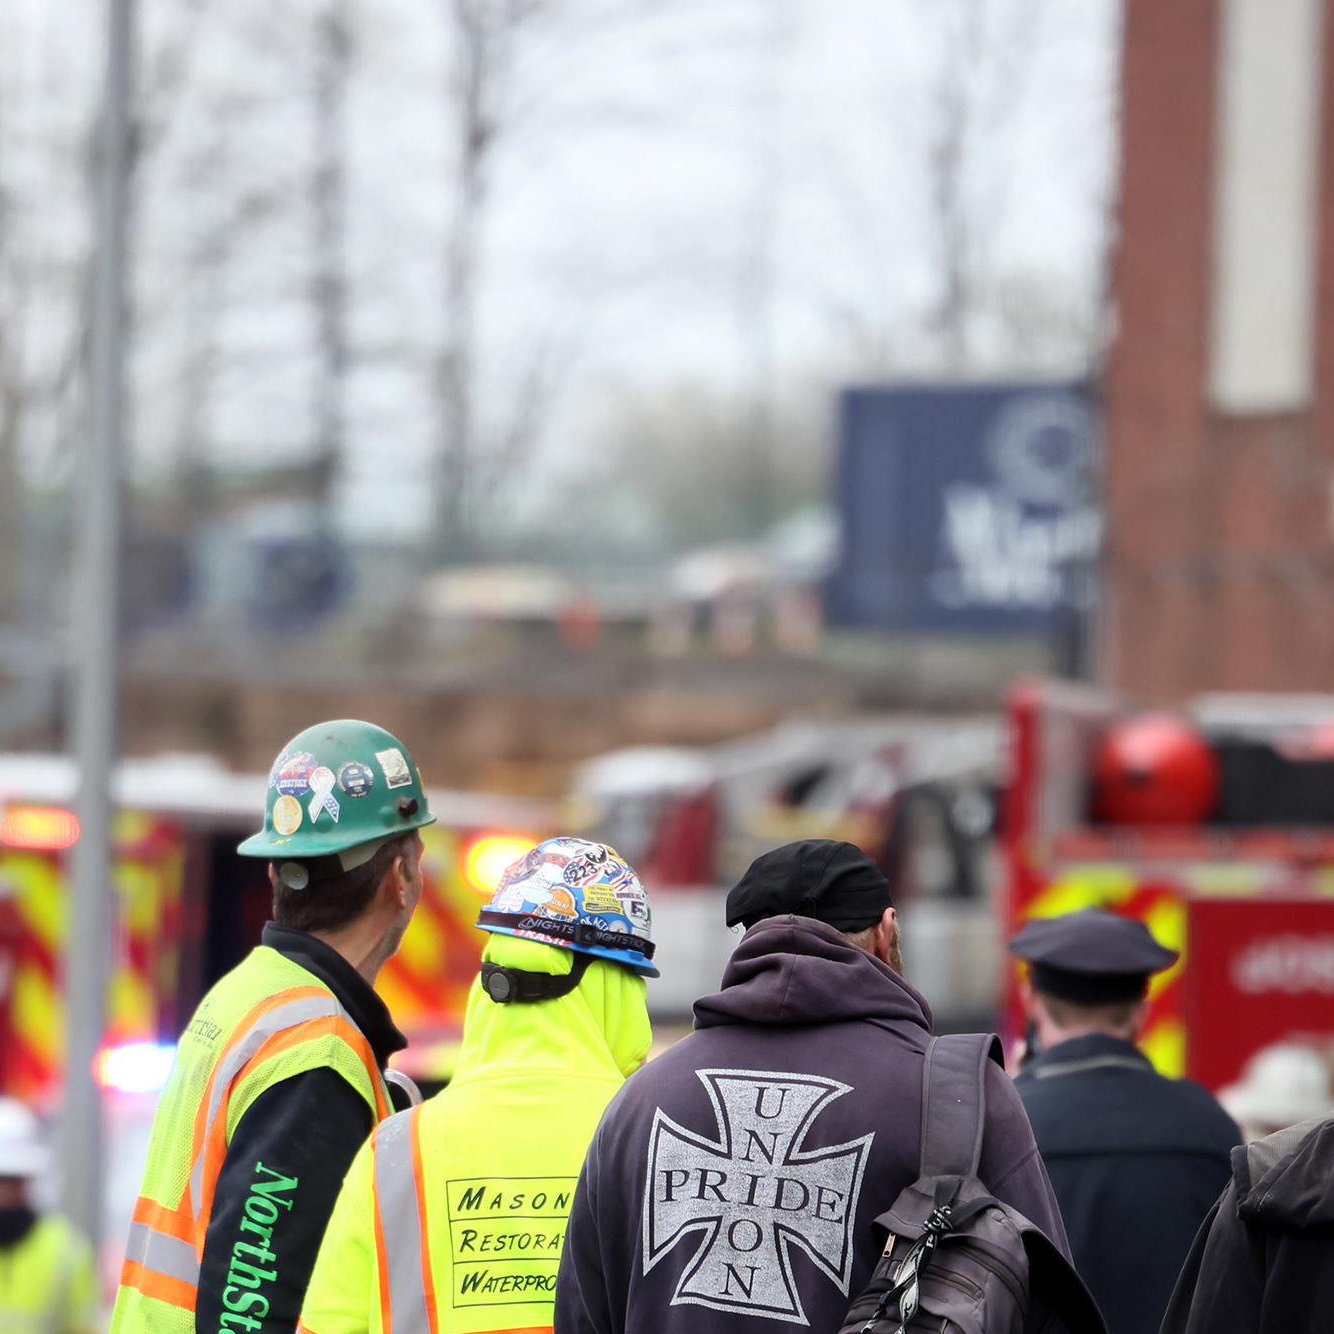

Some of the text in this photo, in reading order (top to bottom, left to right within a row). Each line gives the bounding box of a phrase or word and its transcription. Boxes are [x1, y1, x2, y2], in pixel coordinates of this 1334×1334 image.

[569, 863, 598, 883] 223
[457, 1186, 571, 1212] MASON
[659, 1167, 844, 1225] PRIDE
